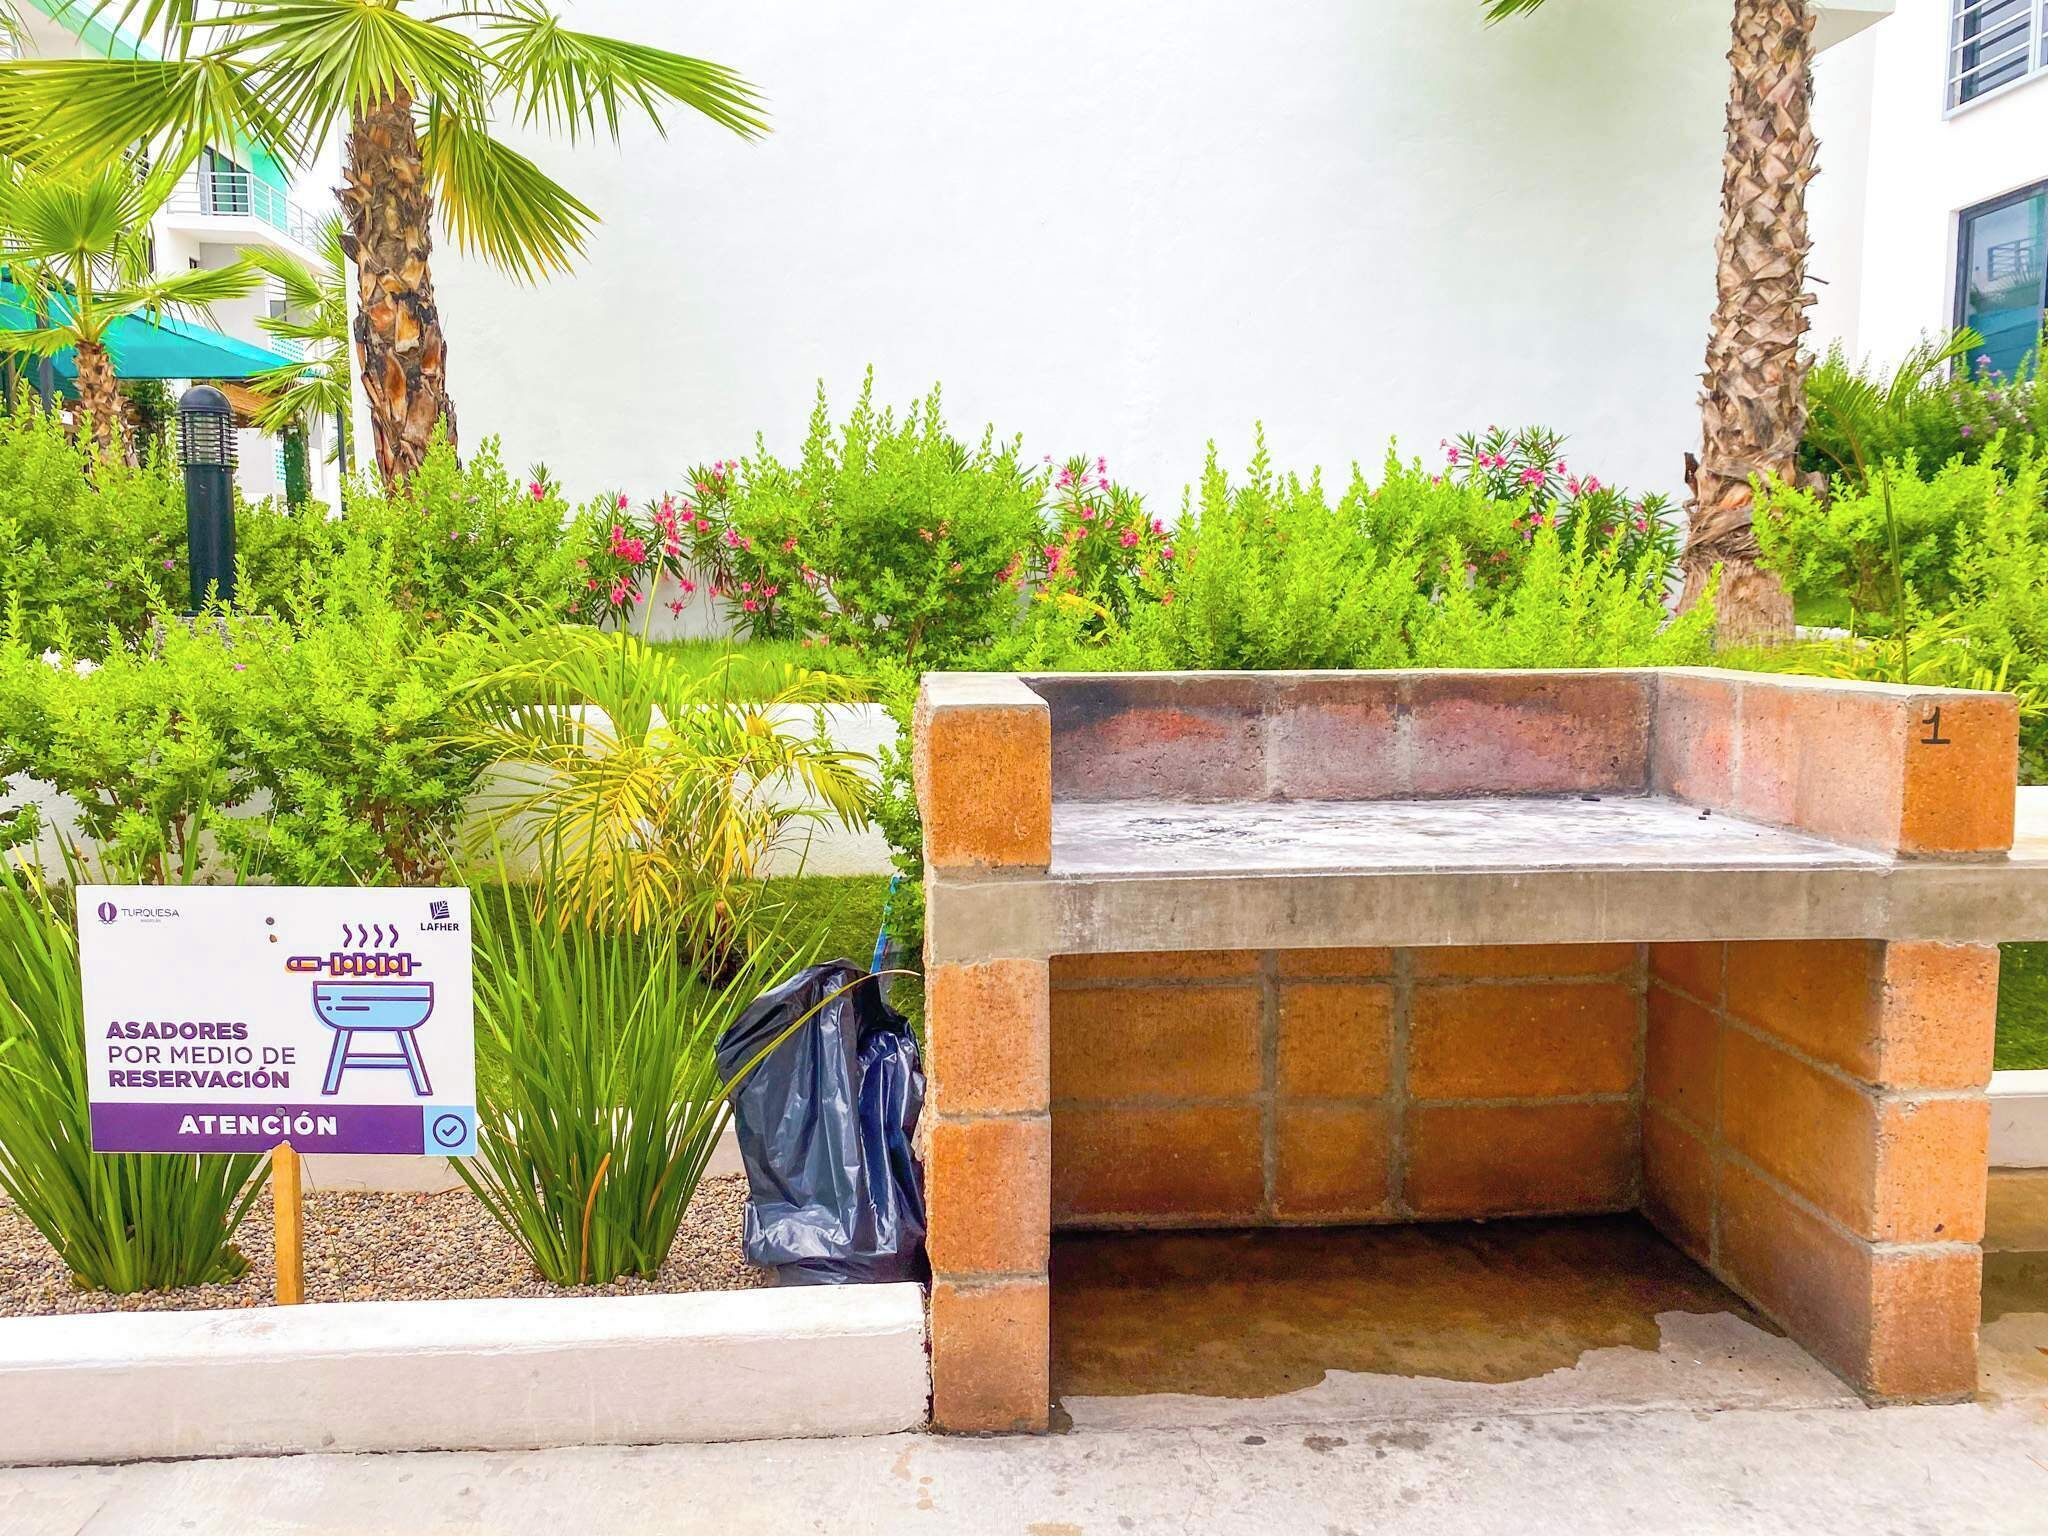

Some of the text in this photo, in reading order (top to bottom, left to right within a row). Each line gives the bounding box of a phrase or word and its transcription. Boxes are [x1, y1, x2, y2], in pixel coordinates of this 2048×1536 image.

[1921, 706, 1951, 744] 1
[121, 908, 180, 917] TURQUESA
[420, 922, 460, 931] LAFHER
[106, 1021, 248, 1040] ASADORES
[108, 1046, 296, 1065] POR MEDIO DE
[109, 1066, 290, 1088] RESERVACIÓN
[178, 1111, 338, 1136] ATENCIÓN
